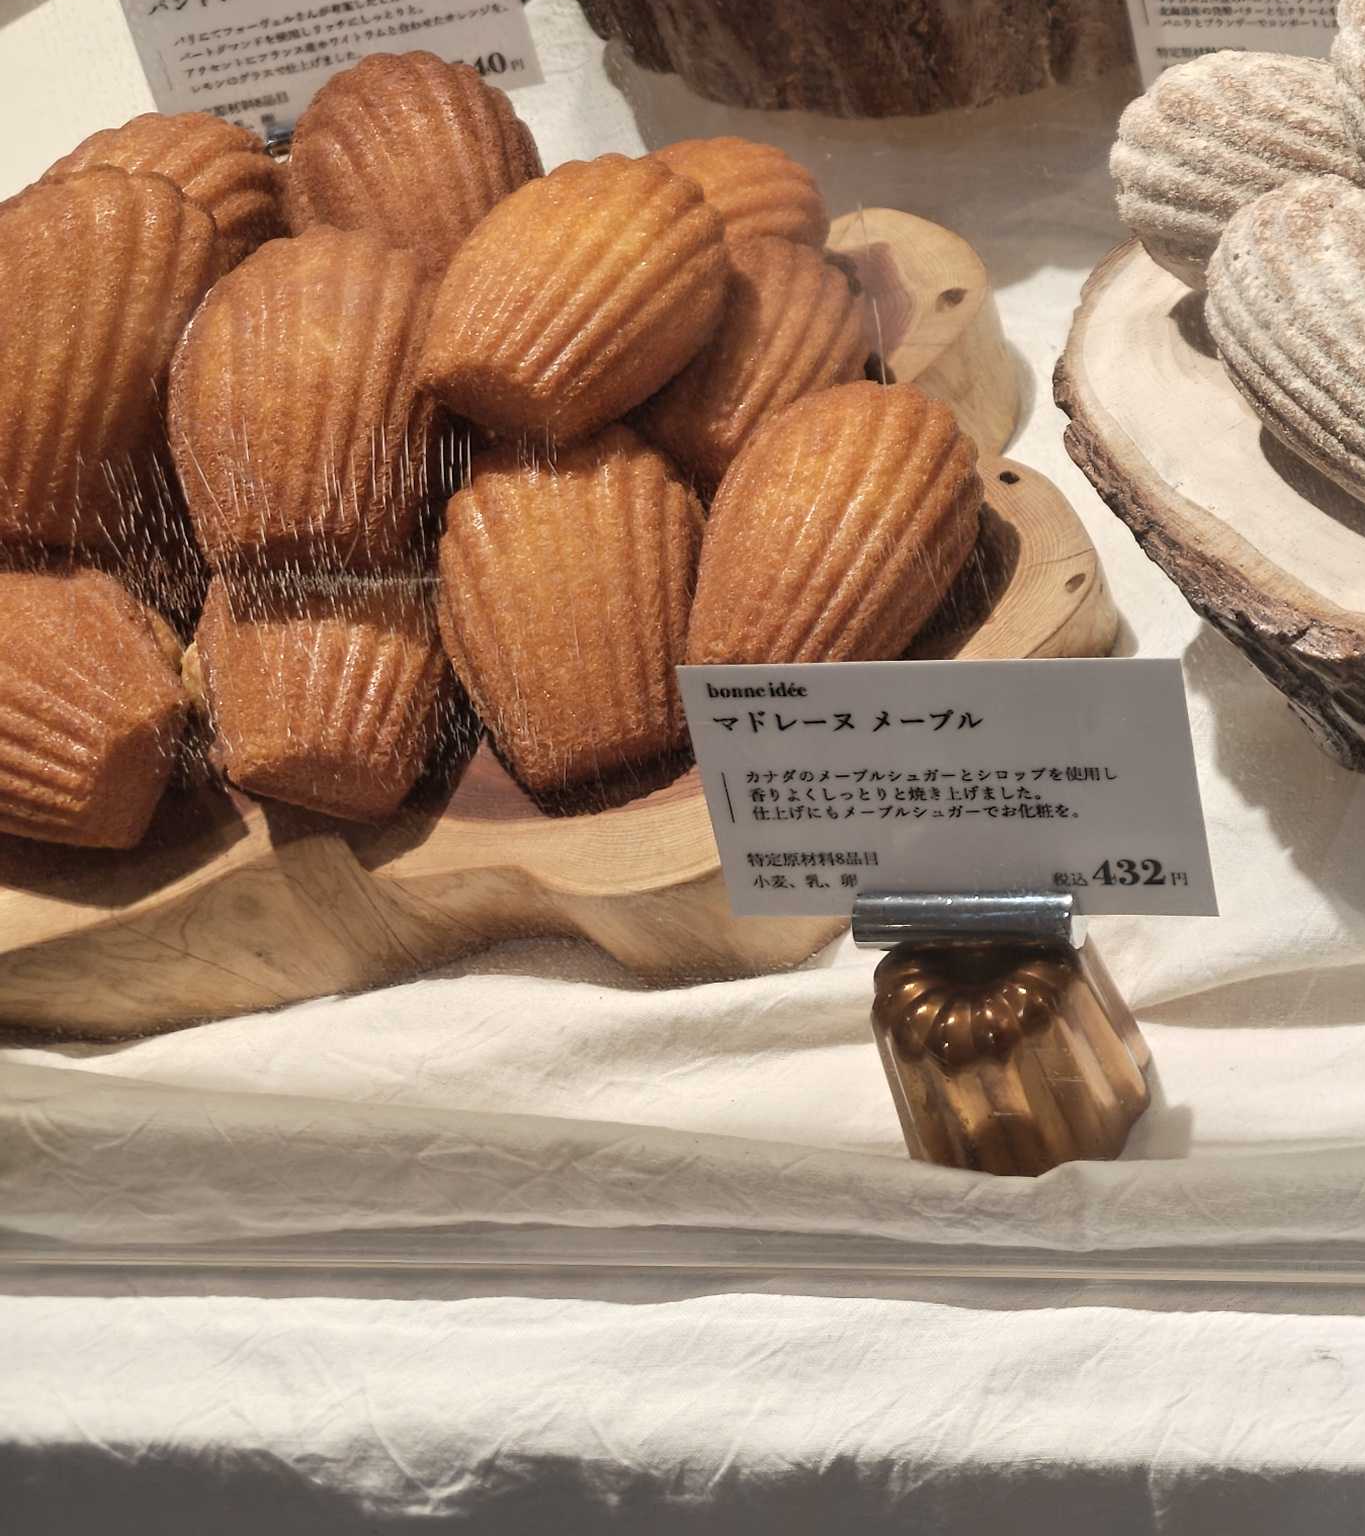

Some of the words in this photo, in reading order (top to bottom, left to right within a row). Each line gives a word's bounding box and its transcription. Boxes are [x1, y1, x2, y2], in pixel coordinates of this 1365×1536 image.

[707, 683, 766, 698] bonne
[768, 682, 807, 697] idée
[713, 711, 855, 733] マドレーヌ
[873, 709, 983, 732] メープル
[750, 785, 1041, 804] 香りよくしっとりと焼き上げました。
[747, 852, 878, 867] 特定原材料8品目
[1053, 872, 1088, 887] 税込
